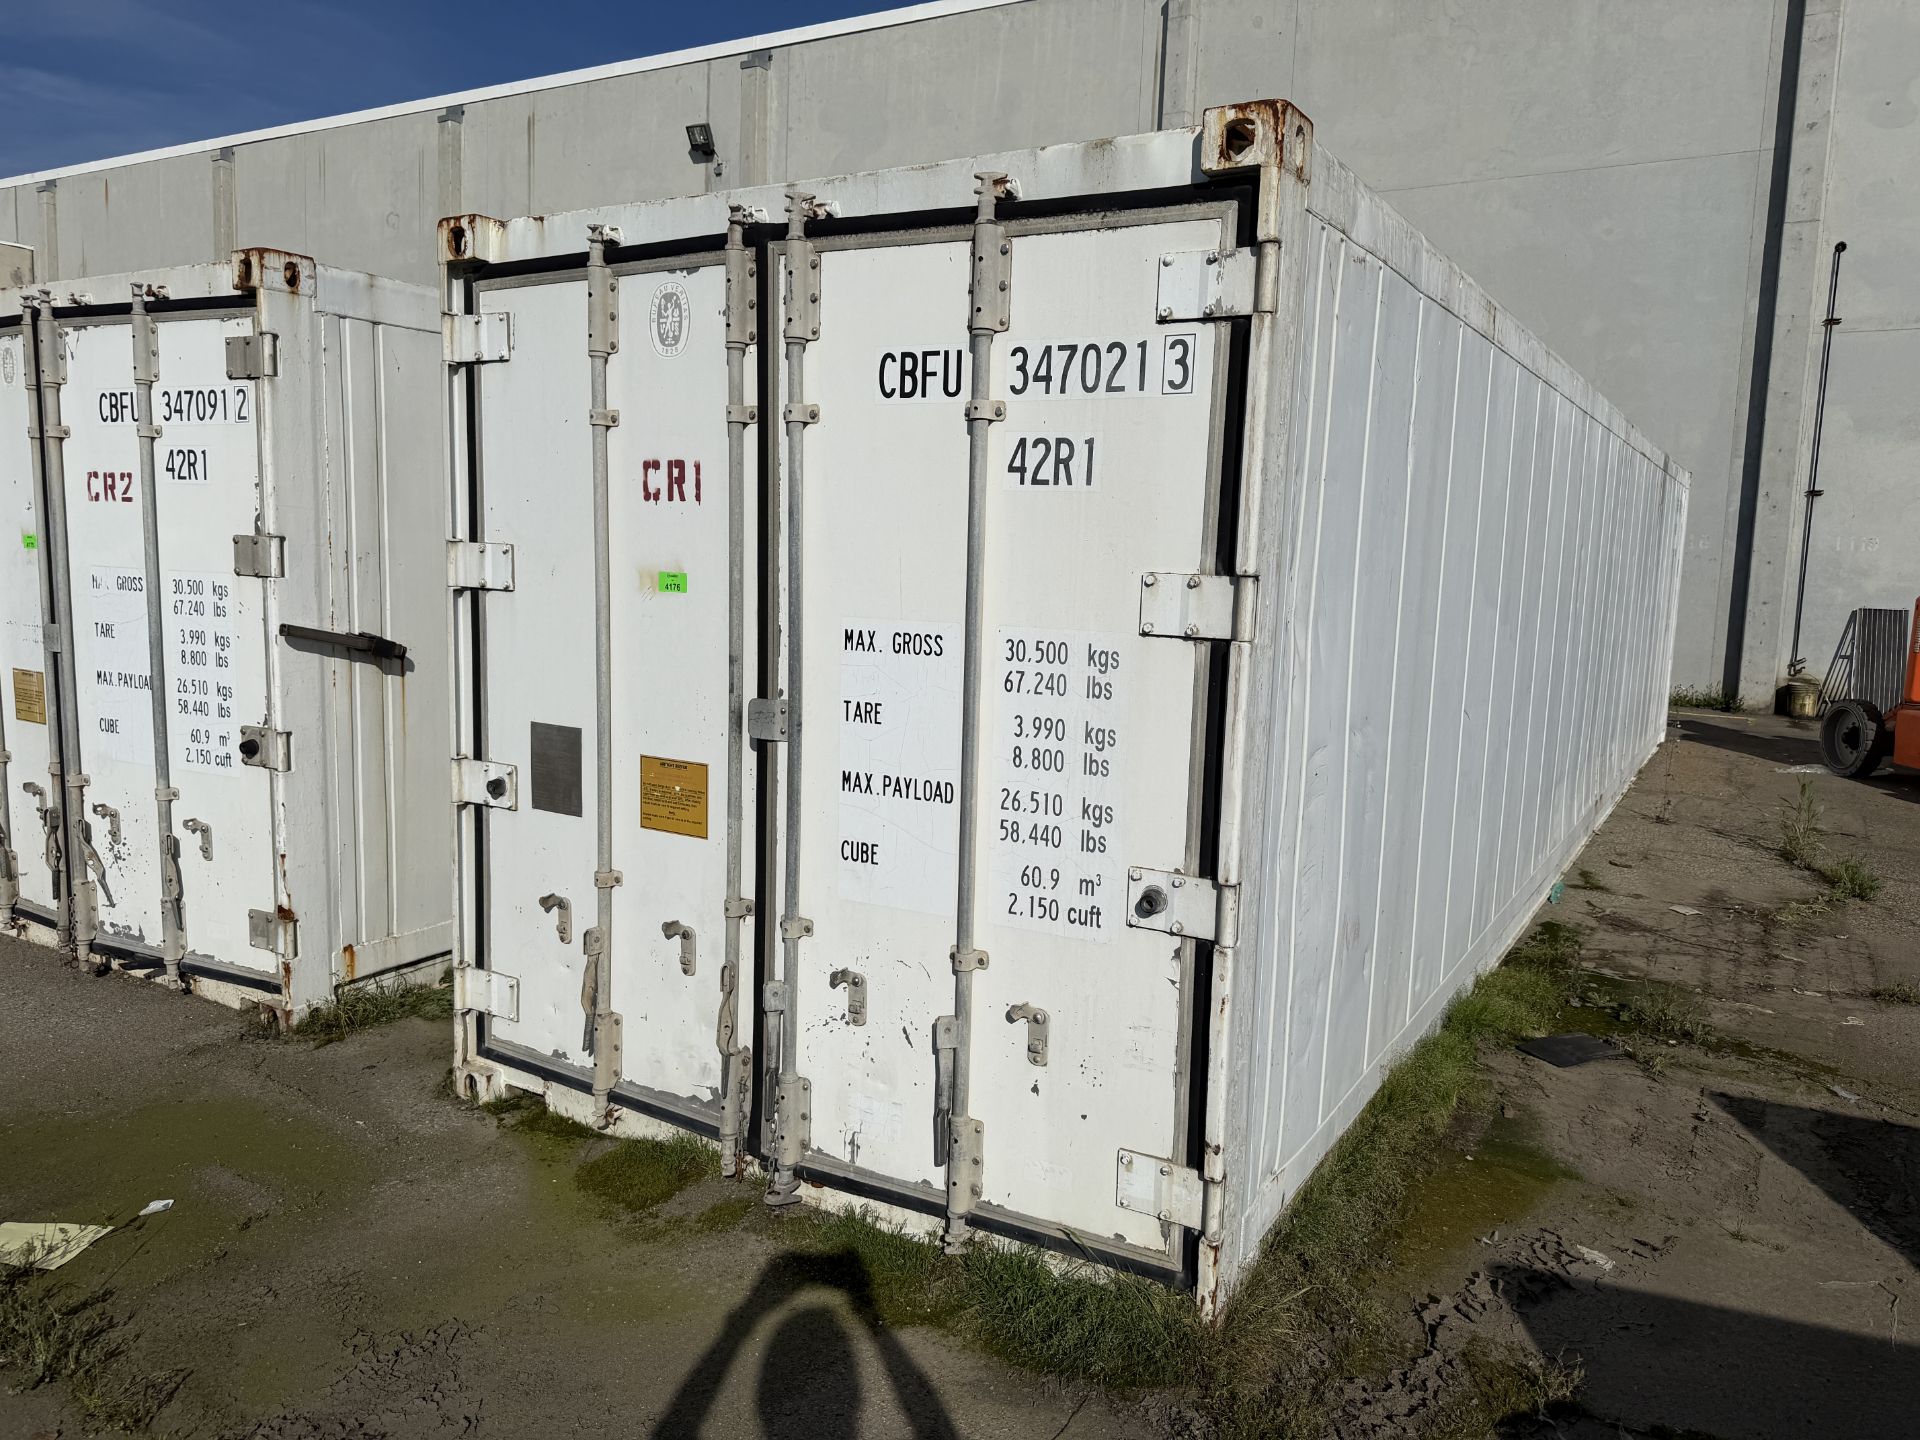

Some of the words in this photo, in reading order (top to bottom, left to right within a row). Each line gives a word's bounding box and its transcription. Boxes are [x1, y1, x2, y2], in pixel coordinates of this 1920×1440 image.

[879, 350, 962, 398] CBFU
[166, 449, 207, 480] 42R1
[1008, 437, 1094, 486] 42R1
[87, 471, 133, 502] CR2
[643, 459, 701, 506] CR1
[117, 576, 143, 592] GROSS
[212, 581, 228, 601] kgs
[214, 600, 226, 617] lbs
[95, 622, 115, 638] TARE
[215, 631, 230, 651] kgs
[845, 629, 882, 652] MAX.
[893, 632, 943, 656] GROSS
[216, 652, 228, 668] lbs
[1088, 643, 1119, 674] kgs
[217, 682, 232, 701] kgs
[1086, 676, 1112, 700] lbs
[218, 703, 230, 718] lbs
[844, 700, 882, 724] TARE
[100, 718, 119, 734] CUBE
[191, 729, 210, 744] 60.9
[1085, 721, 1116, 752] kgs
[215, 753, 232, 768] cuft
[1084, 751, 1109, 777] lbs
[1082, 797, 1113, 828] kgs
[841, 840, 878, 865] CUBE
[1081, 829, 1106, 853] lbs
[1021, 865, 1059, 890] 60.9
[1068, 905, 1101, 928] cuft
